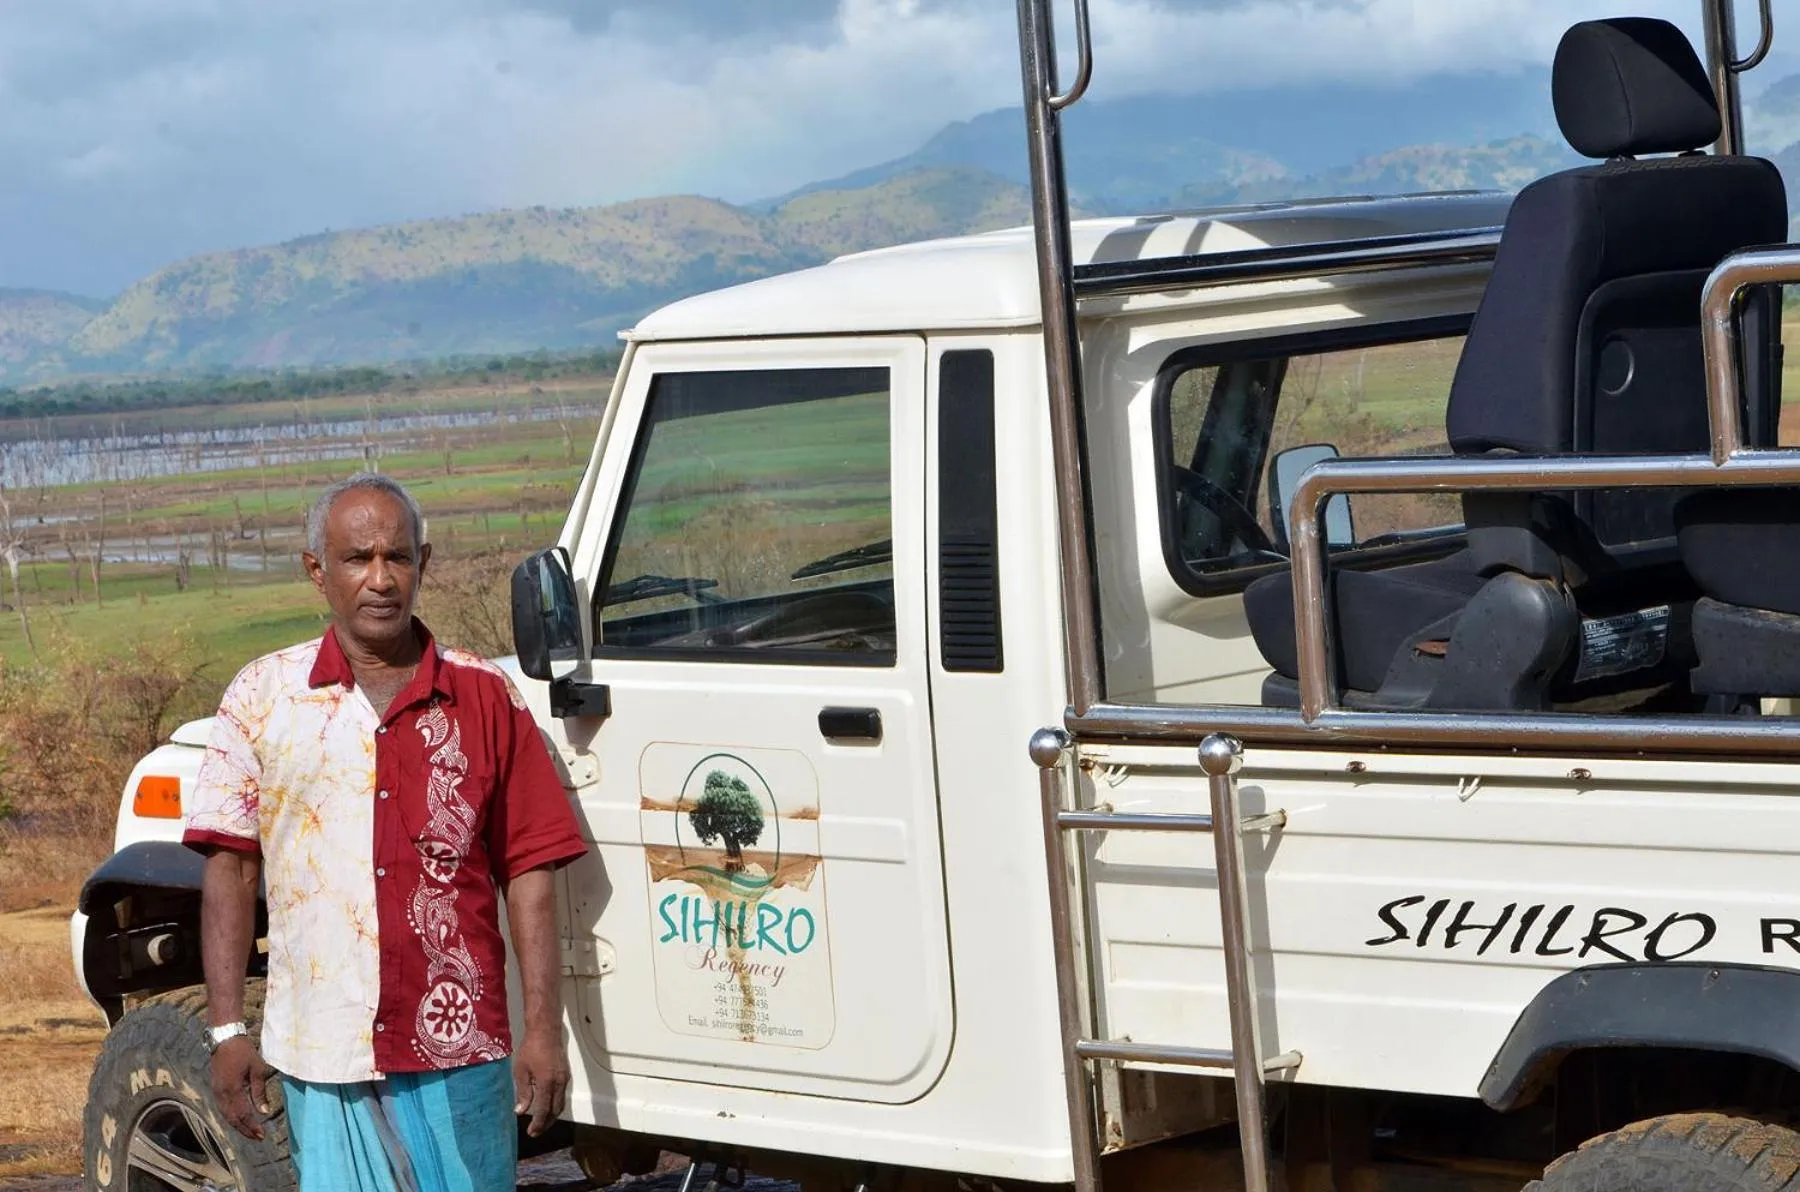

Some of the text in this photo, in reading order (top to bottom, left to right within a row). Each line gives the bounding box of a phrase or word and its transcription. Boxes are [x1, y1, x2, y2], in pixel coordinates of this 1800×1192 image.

[659, 893, 816, 955] SIHILRO
[1366, 895, 1717, 962] SIHILRO
[686, 944, 785, 987] Regency
